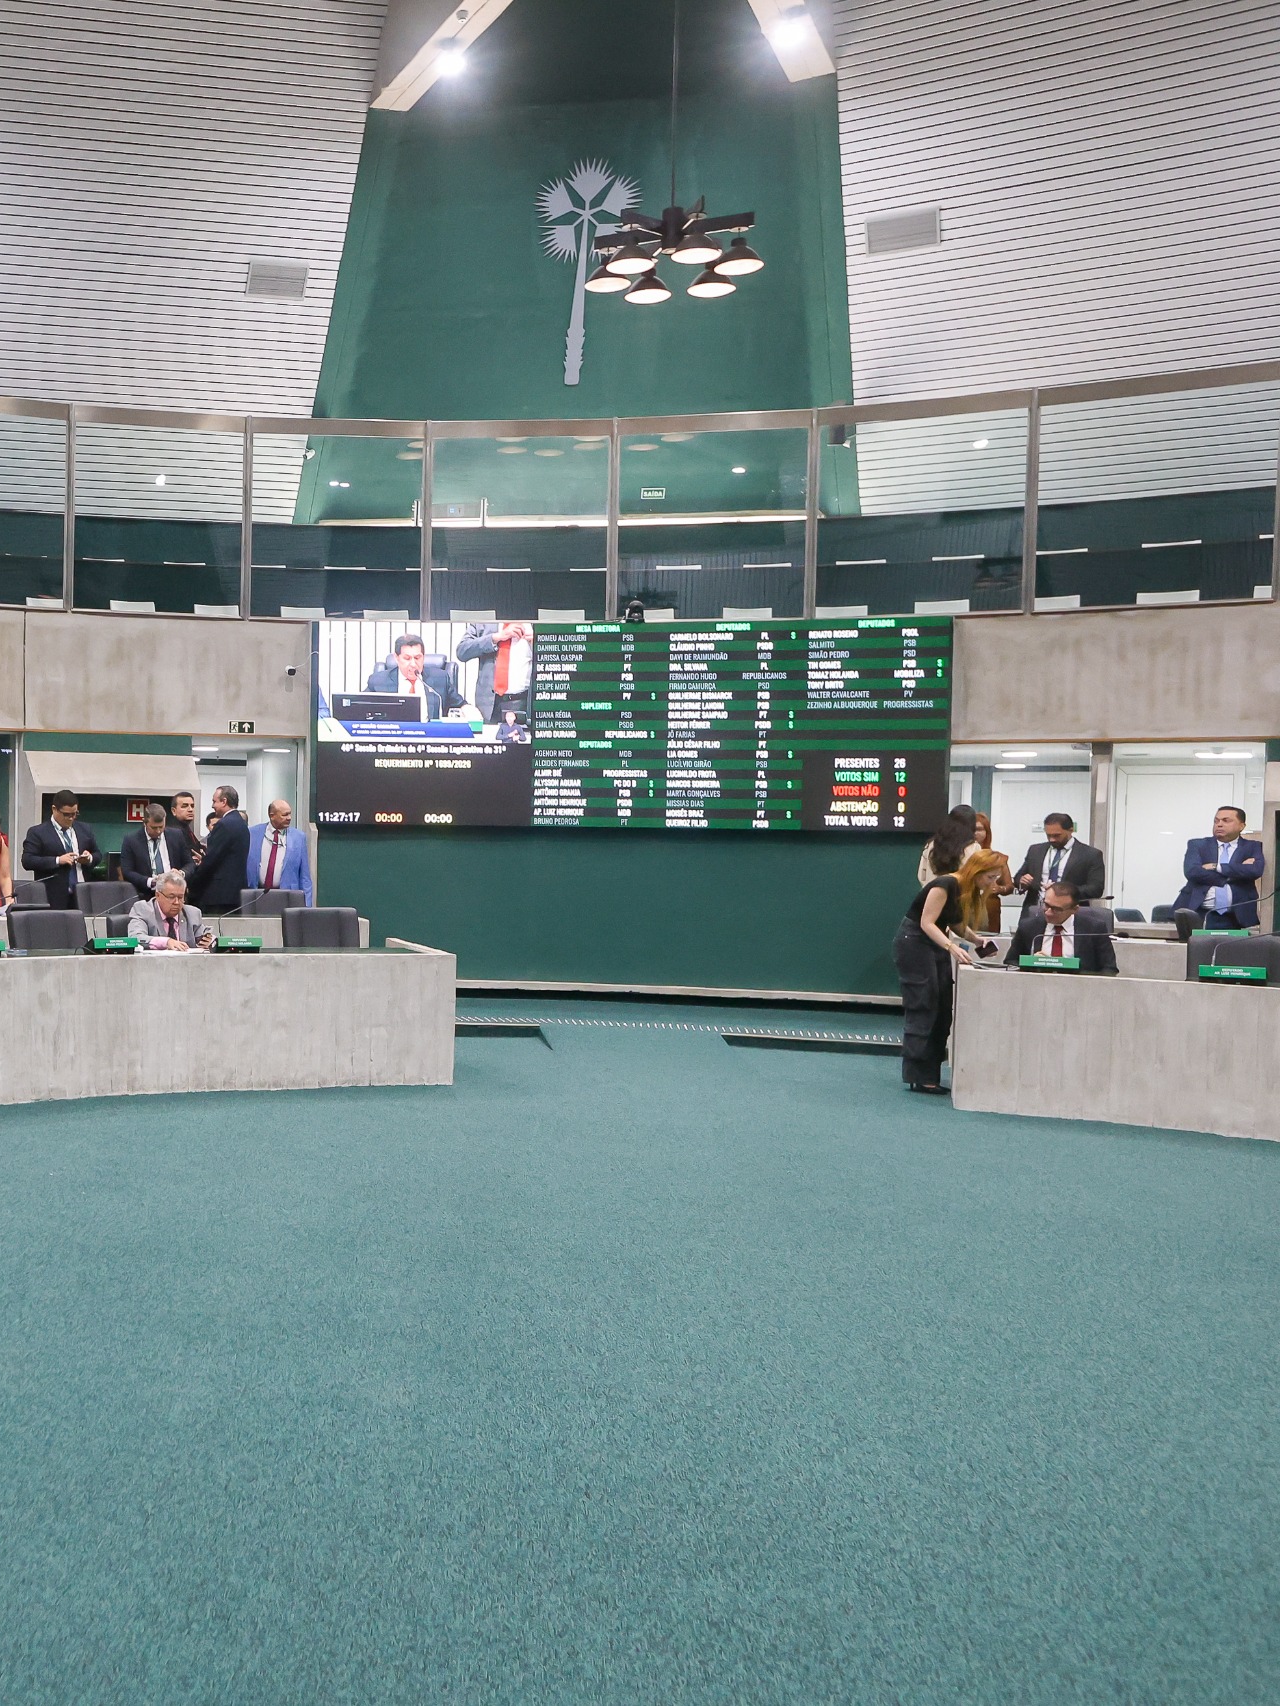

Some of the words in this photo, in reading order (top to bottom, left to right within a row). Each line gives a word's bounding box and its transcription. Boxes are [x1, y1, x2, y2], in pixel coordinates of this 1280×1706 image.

[761, 632, 769, 640] PL
[809, 650, 828, 658] SIMÃO
[761, 662, 768, 670] PL
[833, 701, 877, 709] ALBUQUERQUE
[555, 710, 571, 718] RÉGIA
[375, 759, 423, 768] REQUERIMENTO
[835, 758, 879, 768] PRESENTES
[835, 772, 861, 782] VOTOS
[863, 772, 878, 782] SIM
[895, 772, 905, 782] 12
[833, 786, 859, 796] VOTOS
[861, 784, 879, 796] NÃO
[898, 787, 905, 796] 0
[687, 791, 720, 799] GONÇALVES
[132, 804, 144, 817] H
[830, 800, 878, 814] ABSTENÇÃO
[898, 802, 905, 812] 0
[319, 812, 360, 821] 11:27:17
[375, 813, 402, 823] 00:00
[424, 814, 452, 823] 00:00
[824, 816, 849, 826] TOTAL
[851, 816, 878, 826] VOTOS
[893, 817, 904, 827] 12
